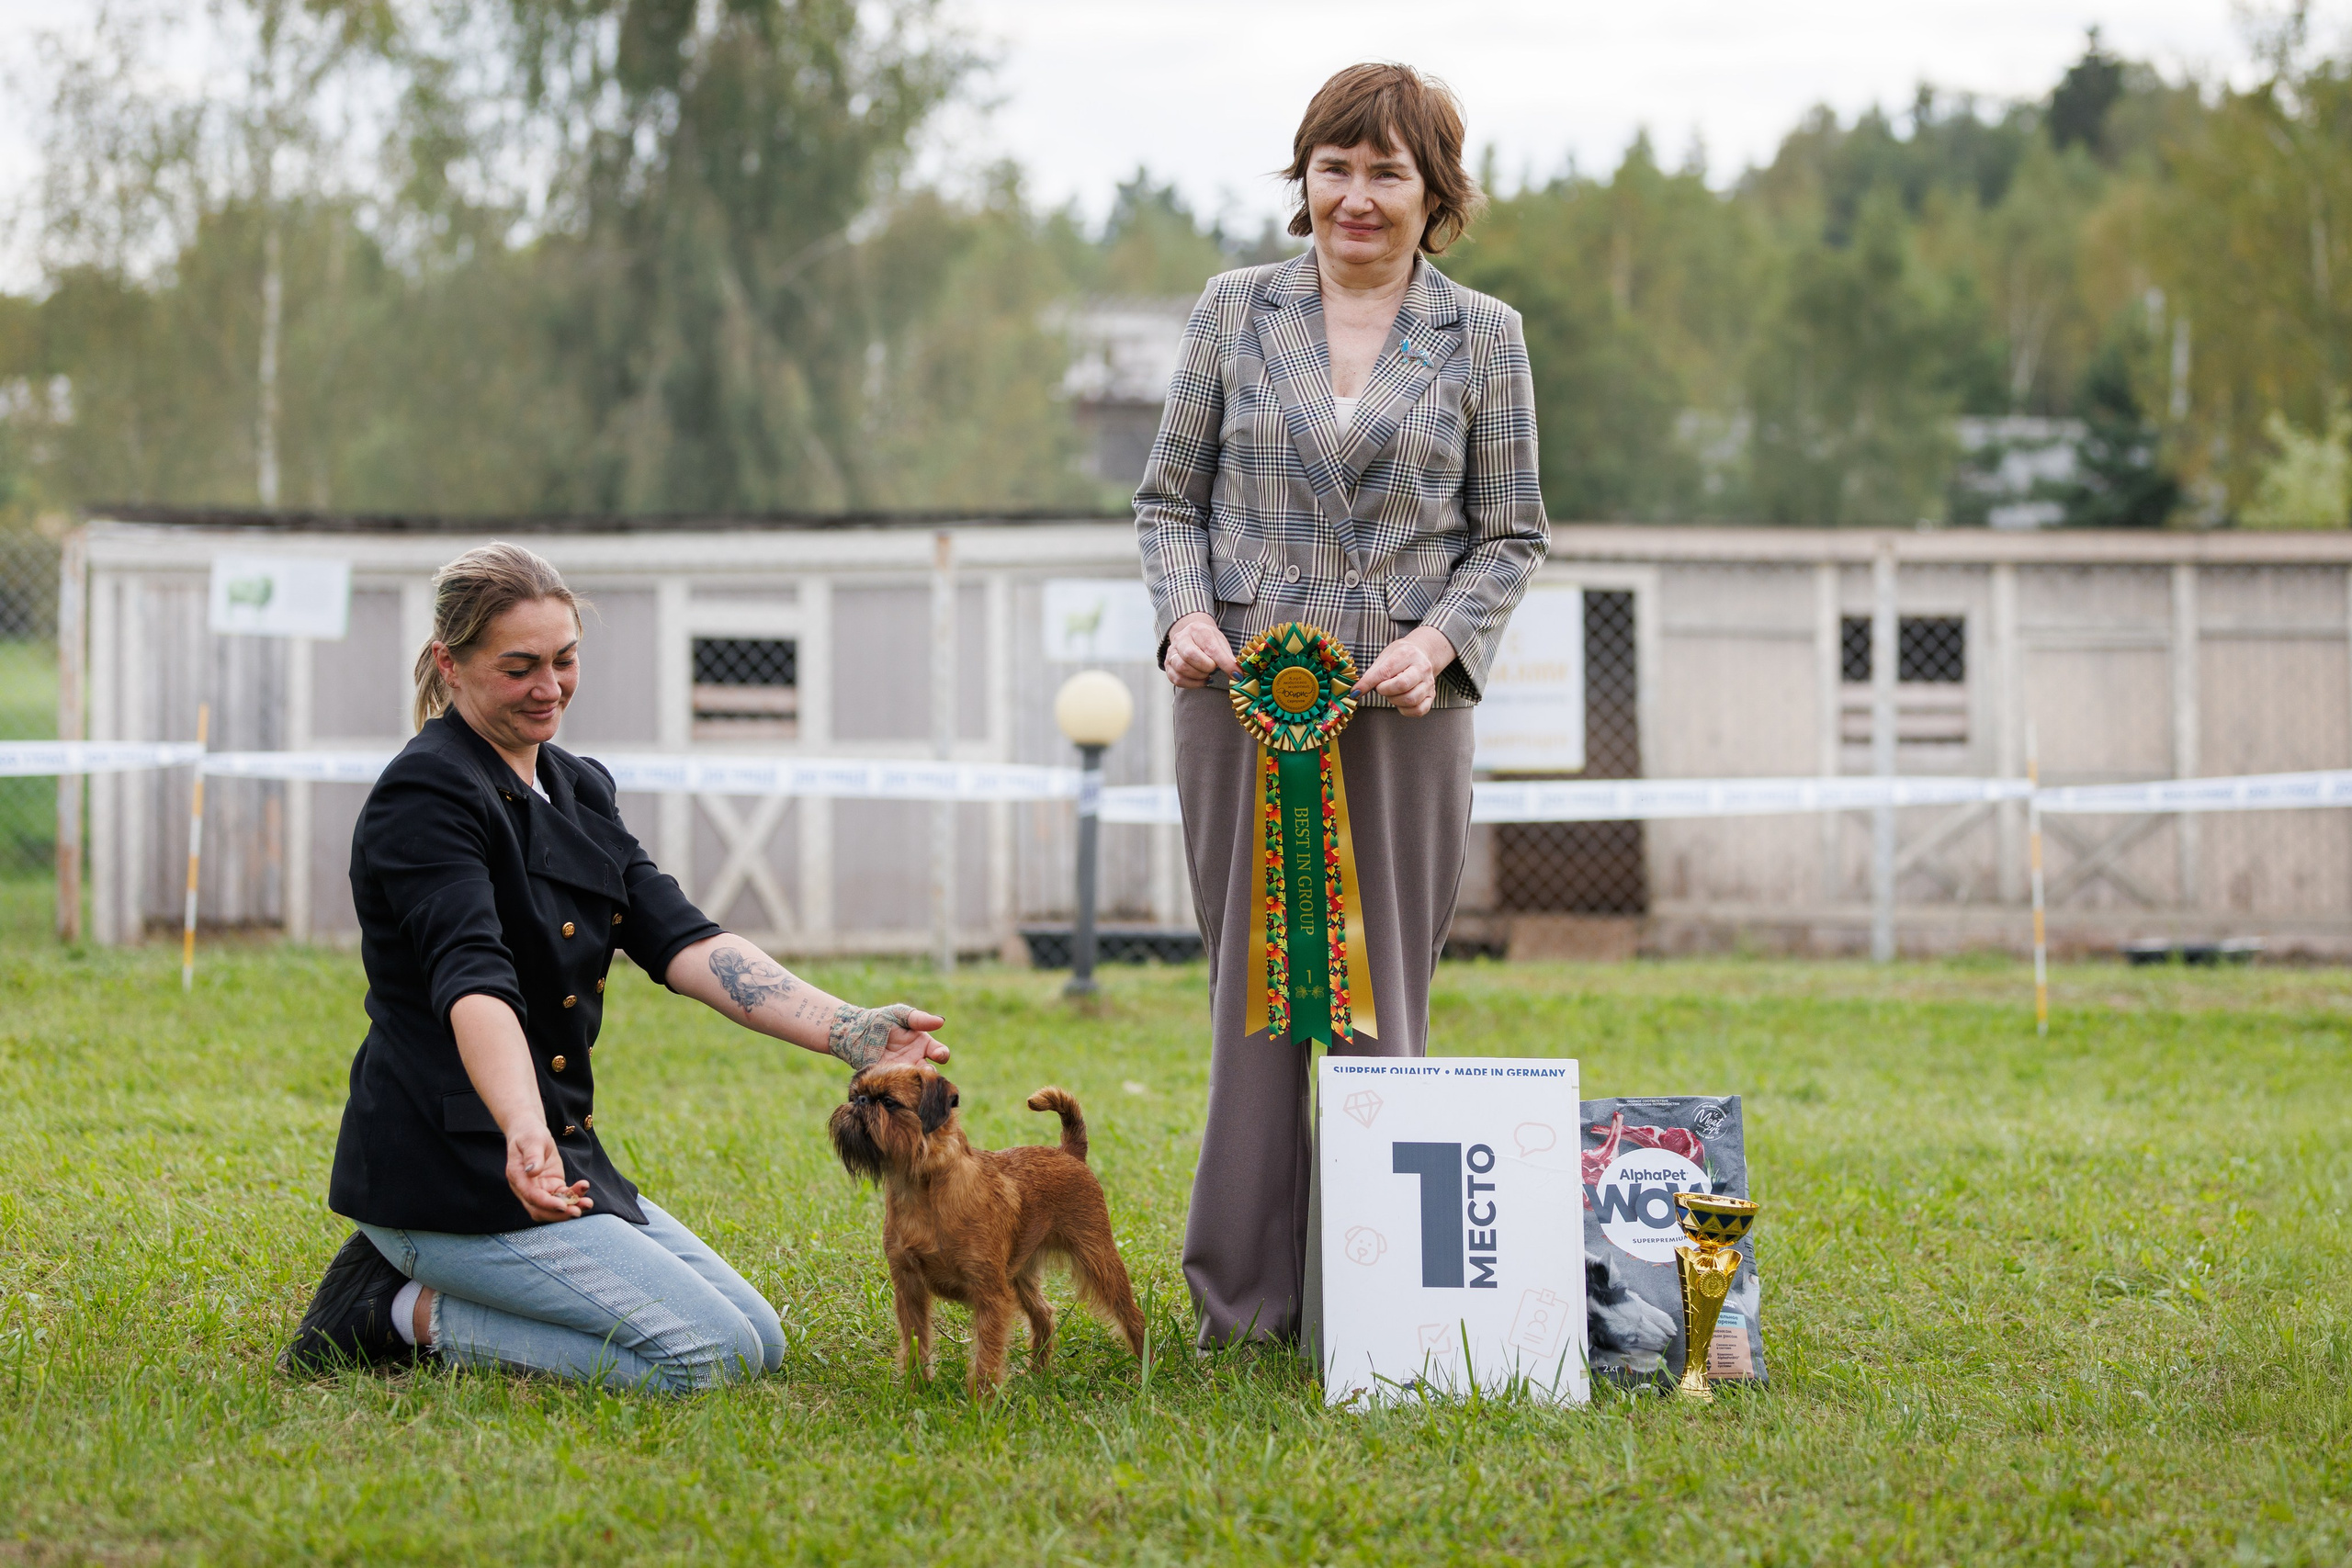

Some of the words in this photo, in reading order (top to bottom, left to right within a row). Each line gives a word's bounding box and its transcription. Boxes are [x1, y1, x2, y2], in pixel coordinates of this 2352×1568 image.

[1295, 807, 1310, 849] BEST
[1296, 852, 1312, 872] IN
[1297, 875, 1315, 935] GROUP
[1454, 1067, 1488, 1077] MADE
[1490, 1068, 1504, 1077] IN
[1506, 1068, 1566, 1077] GERMANY
[1694, 1109, 1724, 1128] Meat
[1620, 1168, 1687, 1182] AlphaPet
[1393, 1142, 1464, 1288] 1
[1466, 1144, 1498, 1288] МЕСТО
[1602, 1364, 1609, 1373] 2
